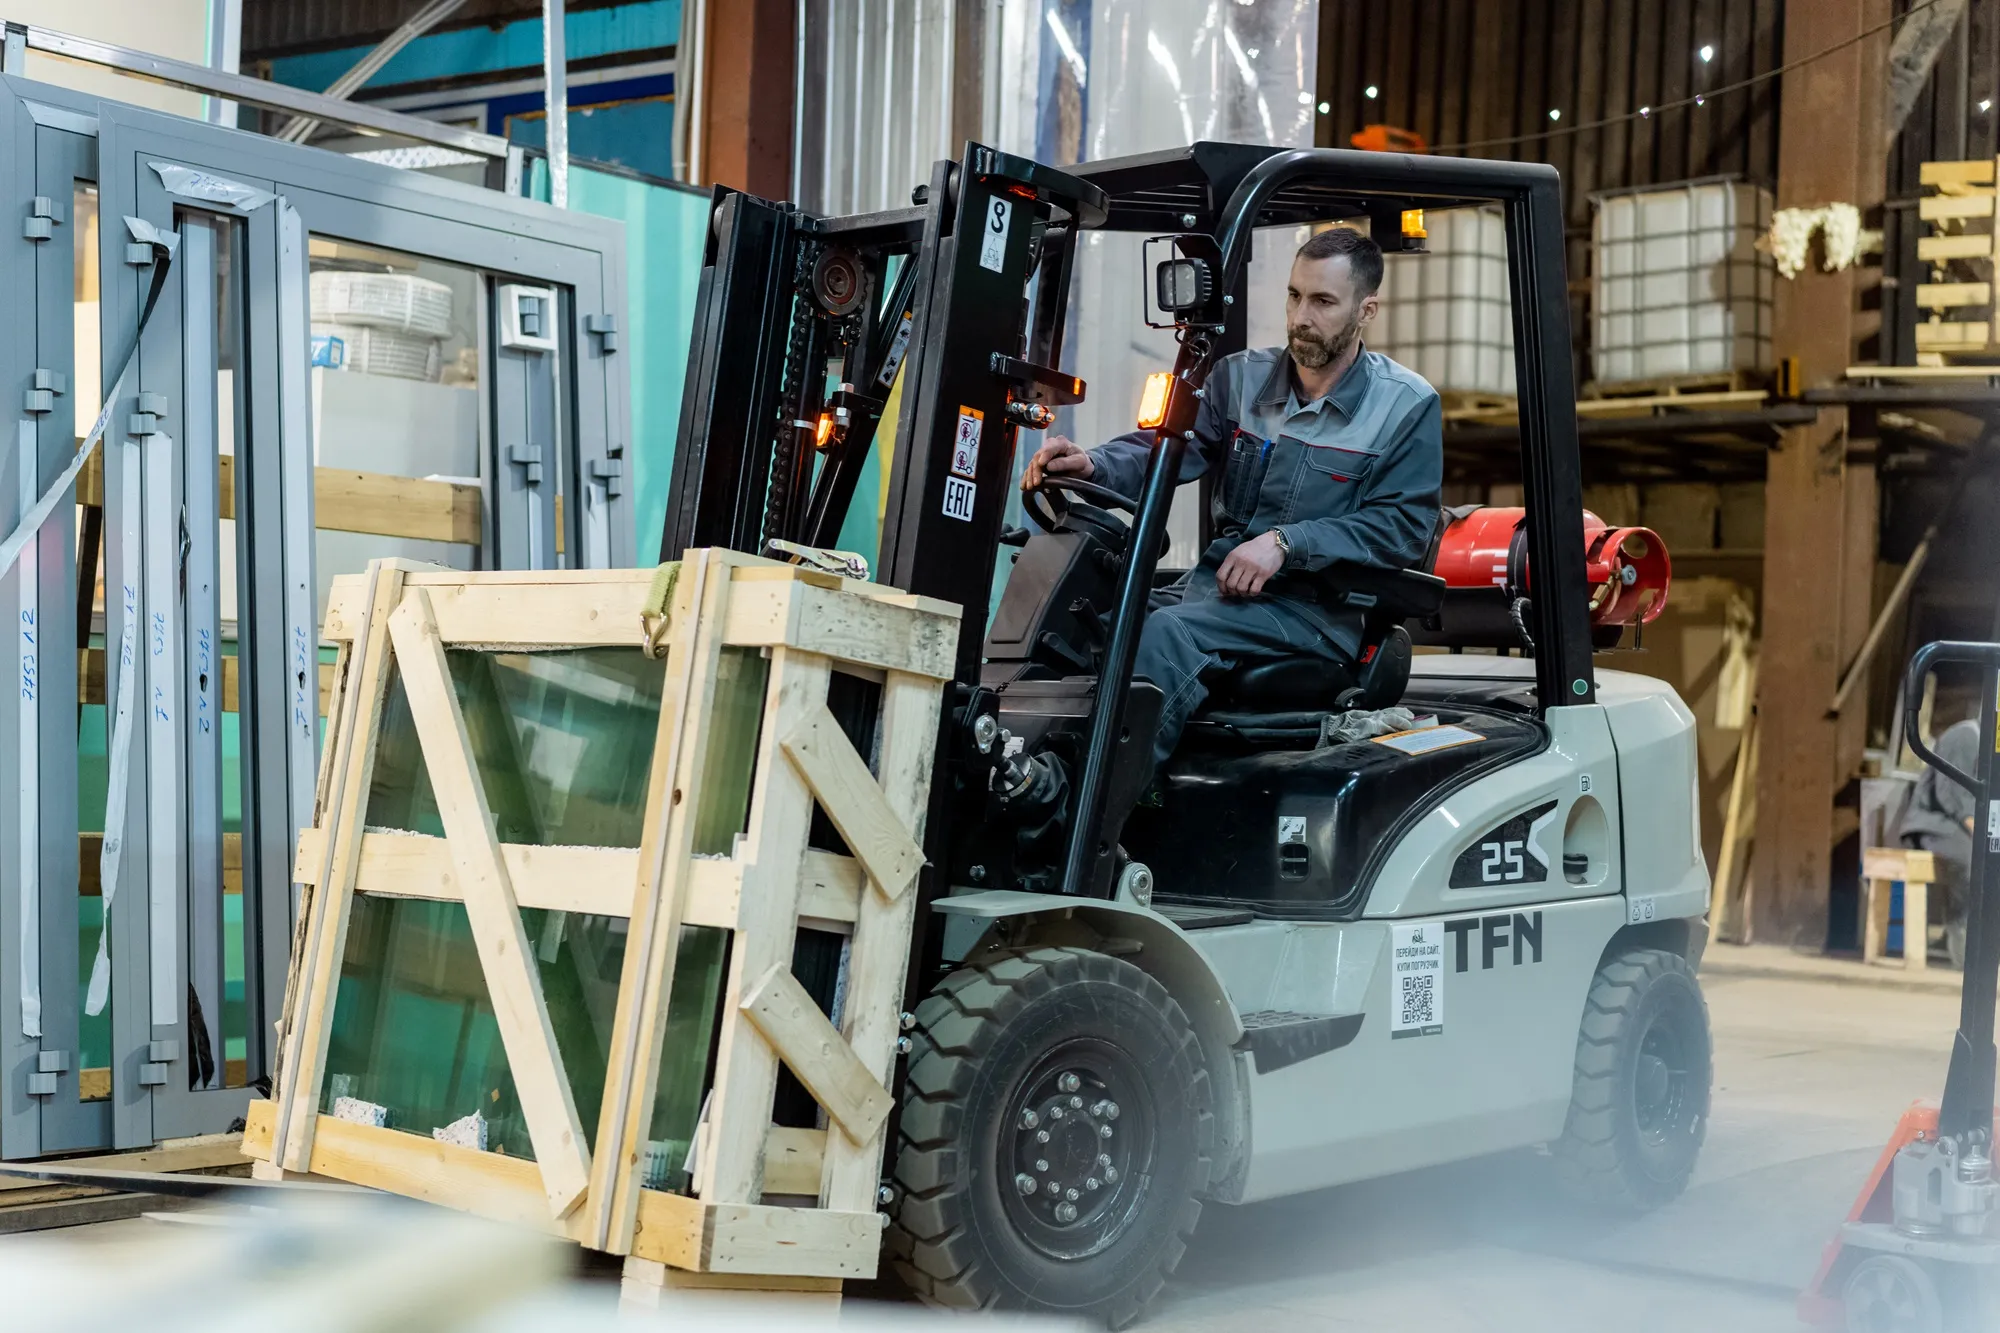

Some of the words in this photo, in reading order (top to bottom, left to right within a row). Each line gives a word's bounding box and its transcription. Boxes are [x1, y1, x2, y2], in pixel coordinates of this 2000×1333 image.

[945, 481, 973, 518] EAC
[22, 608, 35, 625] 2
[22, 654, 36, 701] 7753
[1991, 838, 2000, 851] EA
[1482, 841, 1524, 882] 25
[1396, 946, 1418, 957] ПЕРЕЙДИ
[1419, 946, 1426, 956] НА
[1444, 911, 1543, 974] TFN
[1397, 961, 1410, 972] КУПИ
[1411, 960, 1439, 970] ПОГРУЗЧИК
